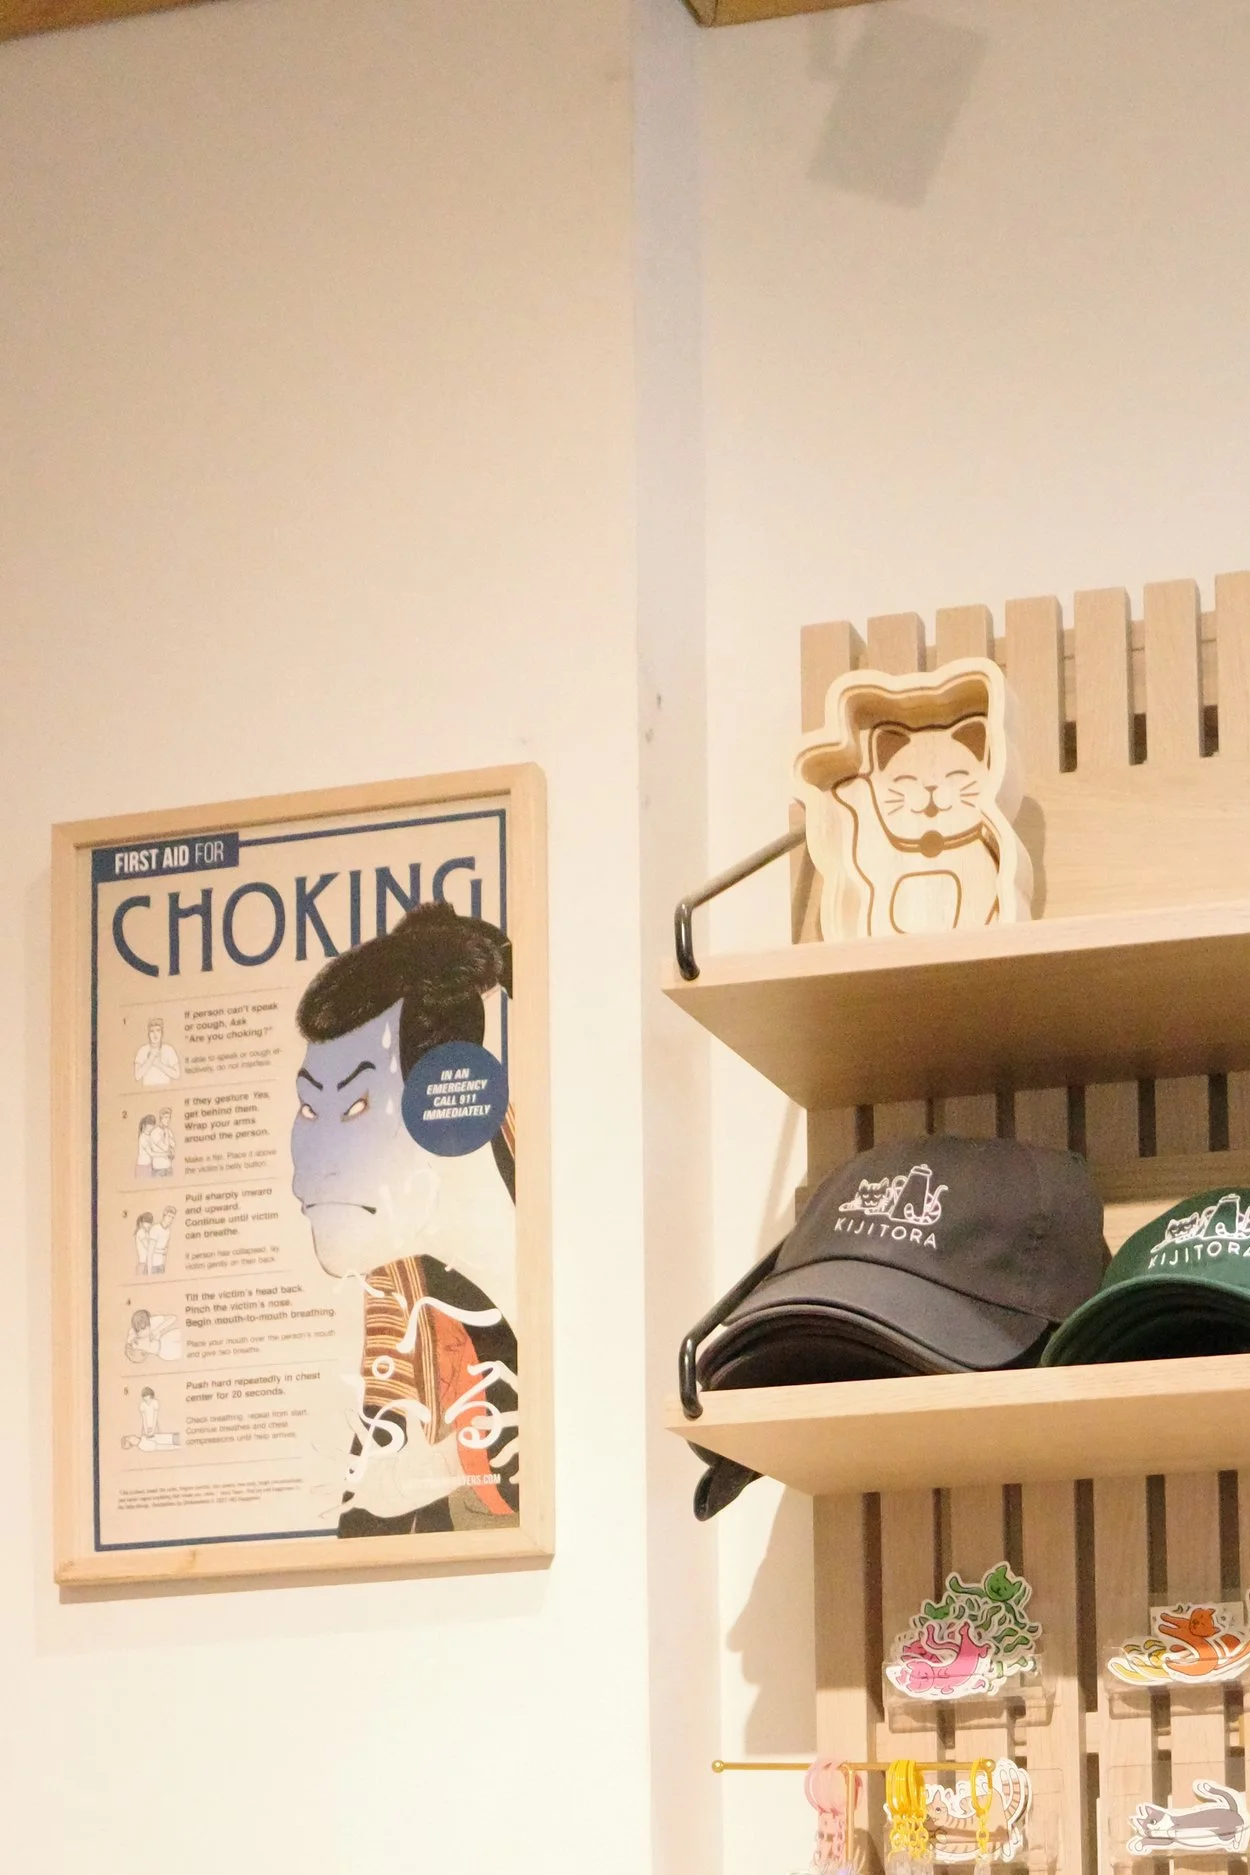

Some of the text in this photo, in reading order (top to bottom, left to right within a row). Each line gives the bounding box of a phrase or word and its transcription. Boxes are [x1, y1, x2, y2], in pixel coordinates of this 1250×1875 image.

[115, 840, 224, 875] FIRST AID FOR
[112, 857, 482, 977] CHOKING
[193, 1008, 224, 1019] person
[227, 1005, 249, 1014] can't
[251, 1002, 278, 1014] speak
[185, 1023, 193, 1031] or
[230, 1018, 246, 1026] Ask
[208, 1033, 224, 1043] you
[441, 1068, 470, 1080] IN AN
[427, 1080, 488, 1095] EMERGENCY
[193, 1096, 211, 1106] they
[215, 1093, 249, 1106] gesture
[434, 1093, 476, 1107] CALL 911
[184, 1111, 198, 1120] get
[201, 1106, 232, 1117] behind
[423, 1104, 491, 1120] IMMEDIATELY
[185, 1118, 255, 1132] Wrap your arms
[184, 1134, 216, 1143] around
[236, 1129, 270, 1140] person.
[186, 1187, 272, 1203] Pull sharply inward
[185, 1206, 201, 1215] and
[185, 1211, 278, 1228] Continue until victim
[185, 1228, 239, 1240] can breathe.
[834, 1218, 937, 1249] KIJITORA
[185, 1293, 198, 1302] Tilt
[202, 1291, 215, 1300] the
[219, 1288, 253, 1299] victim's
[256, 1287, 277, 1296] head
[185, 1305, 210, 1314] Pinch
[213, 1304, 227, 1312] the
[230, 1301, 265, 1311] victim's
[185, 1308, 336, 1328] Begin mouth-to-mouth breathing.
[186, 1372, 320, 1390] Push hard repeatedly in chest
[185, 1387, 286, 1402] center for 20 seconds.
